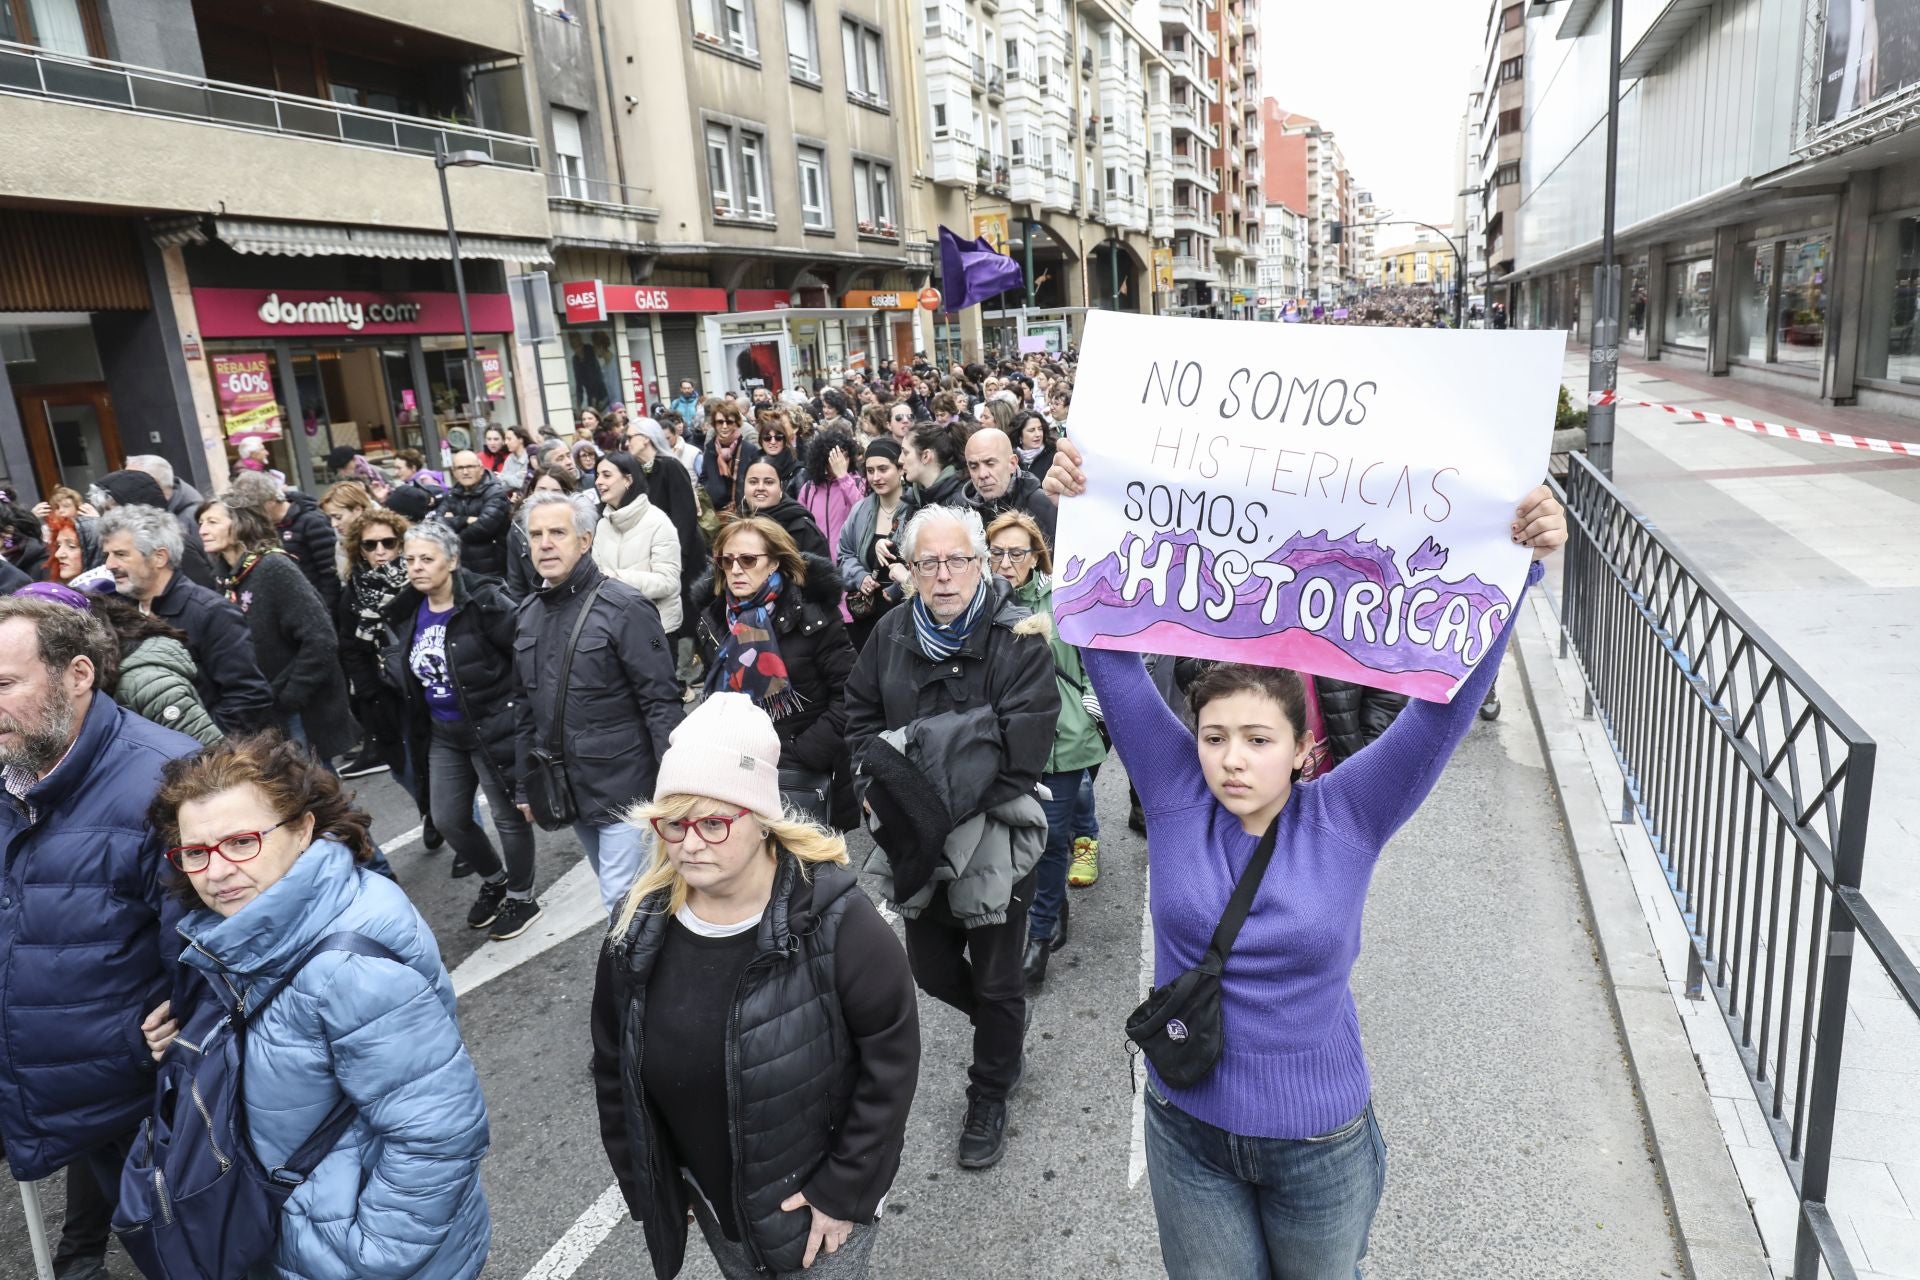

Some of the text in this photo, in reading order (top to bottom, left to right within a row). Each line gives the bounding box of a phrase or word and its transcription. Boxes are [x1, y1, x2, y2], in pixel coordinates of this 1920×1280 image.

[258, 293, 417, 330] dormity.com
[566, 292, 596, 306] GAES
[634, 290, 669, 310] GAES
[215, 361, 266, 375] REBAJAS
[220, 372, 269, 394] -60%
[1141, 359, 1378, 426] NO SOMOS
[1151, 426, 1460, 523] HISTERICAS
[1120, 536, 1512, 667] HISTORICAS
